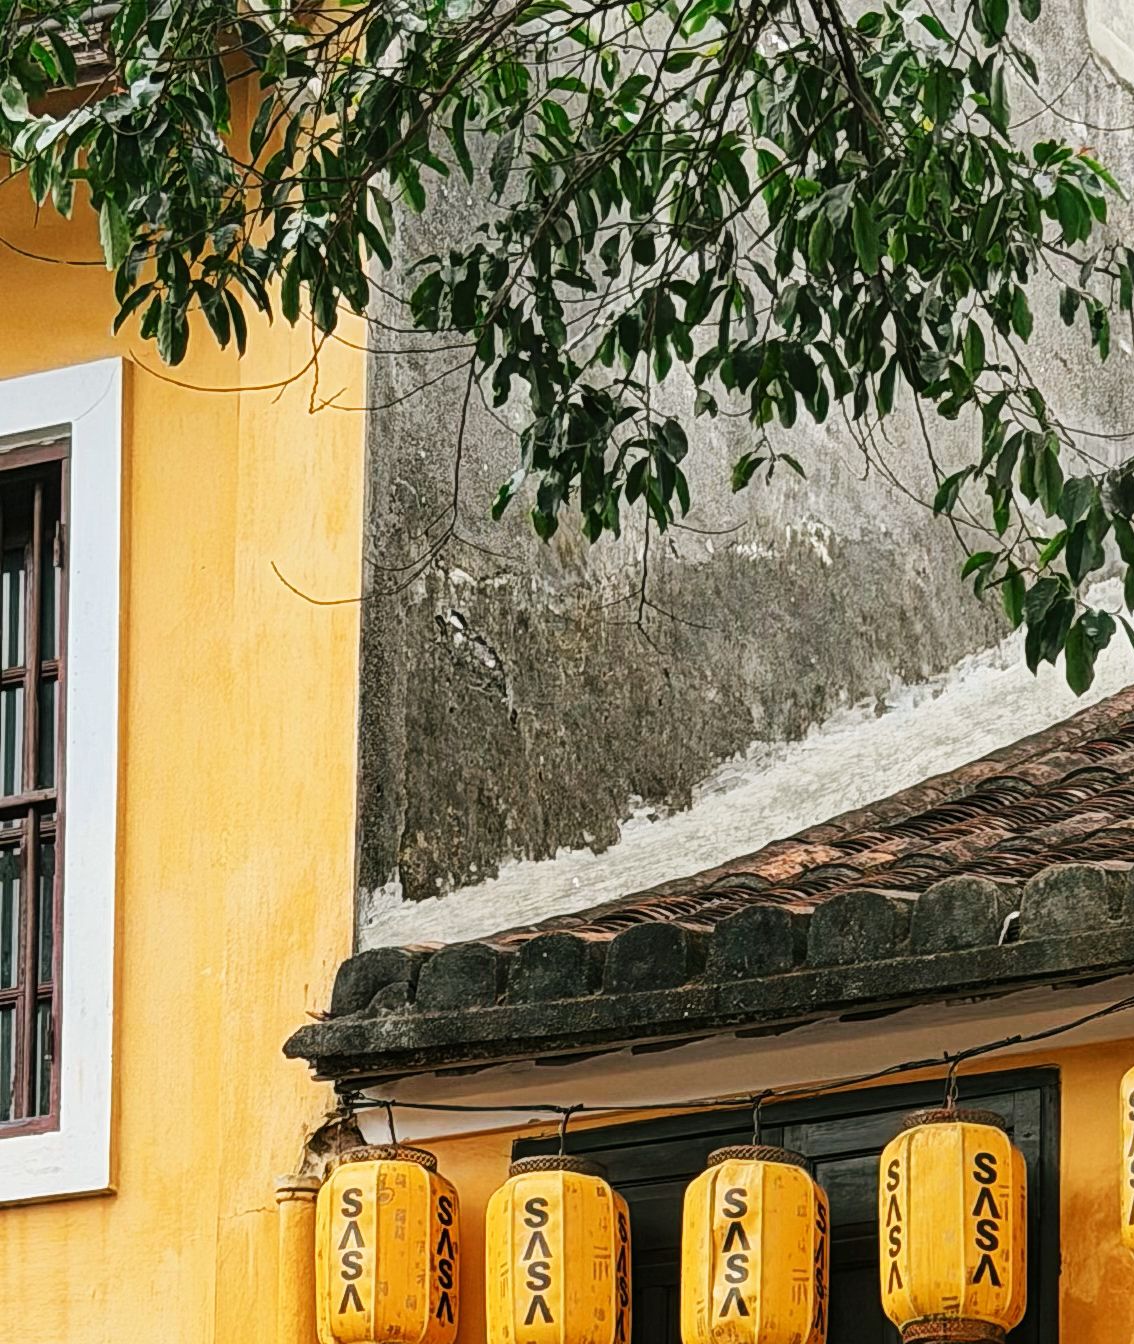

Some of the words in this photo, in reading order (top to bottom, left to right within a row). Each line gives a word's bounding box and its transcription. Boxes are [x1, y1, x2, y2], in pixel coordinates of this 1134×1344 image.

[339, 1187, 366, 1316] SASA
[436, 1195, 456, 1326] SASA
[524, 1197, 554, 1326] SASA
[719, 1188, 751, 1318] SASA
[886, 1159, 902, 1292] SASA
[973, 1152, 1002, 1288] SASA
